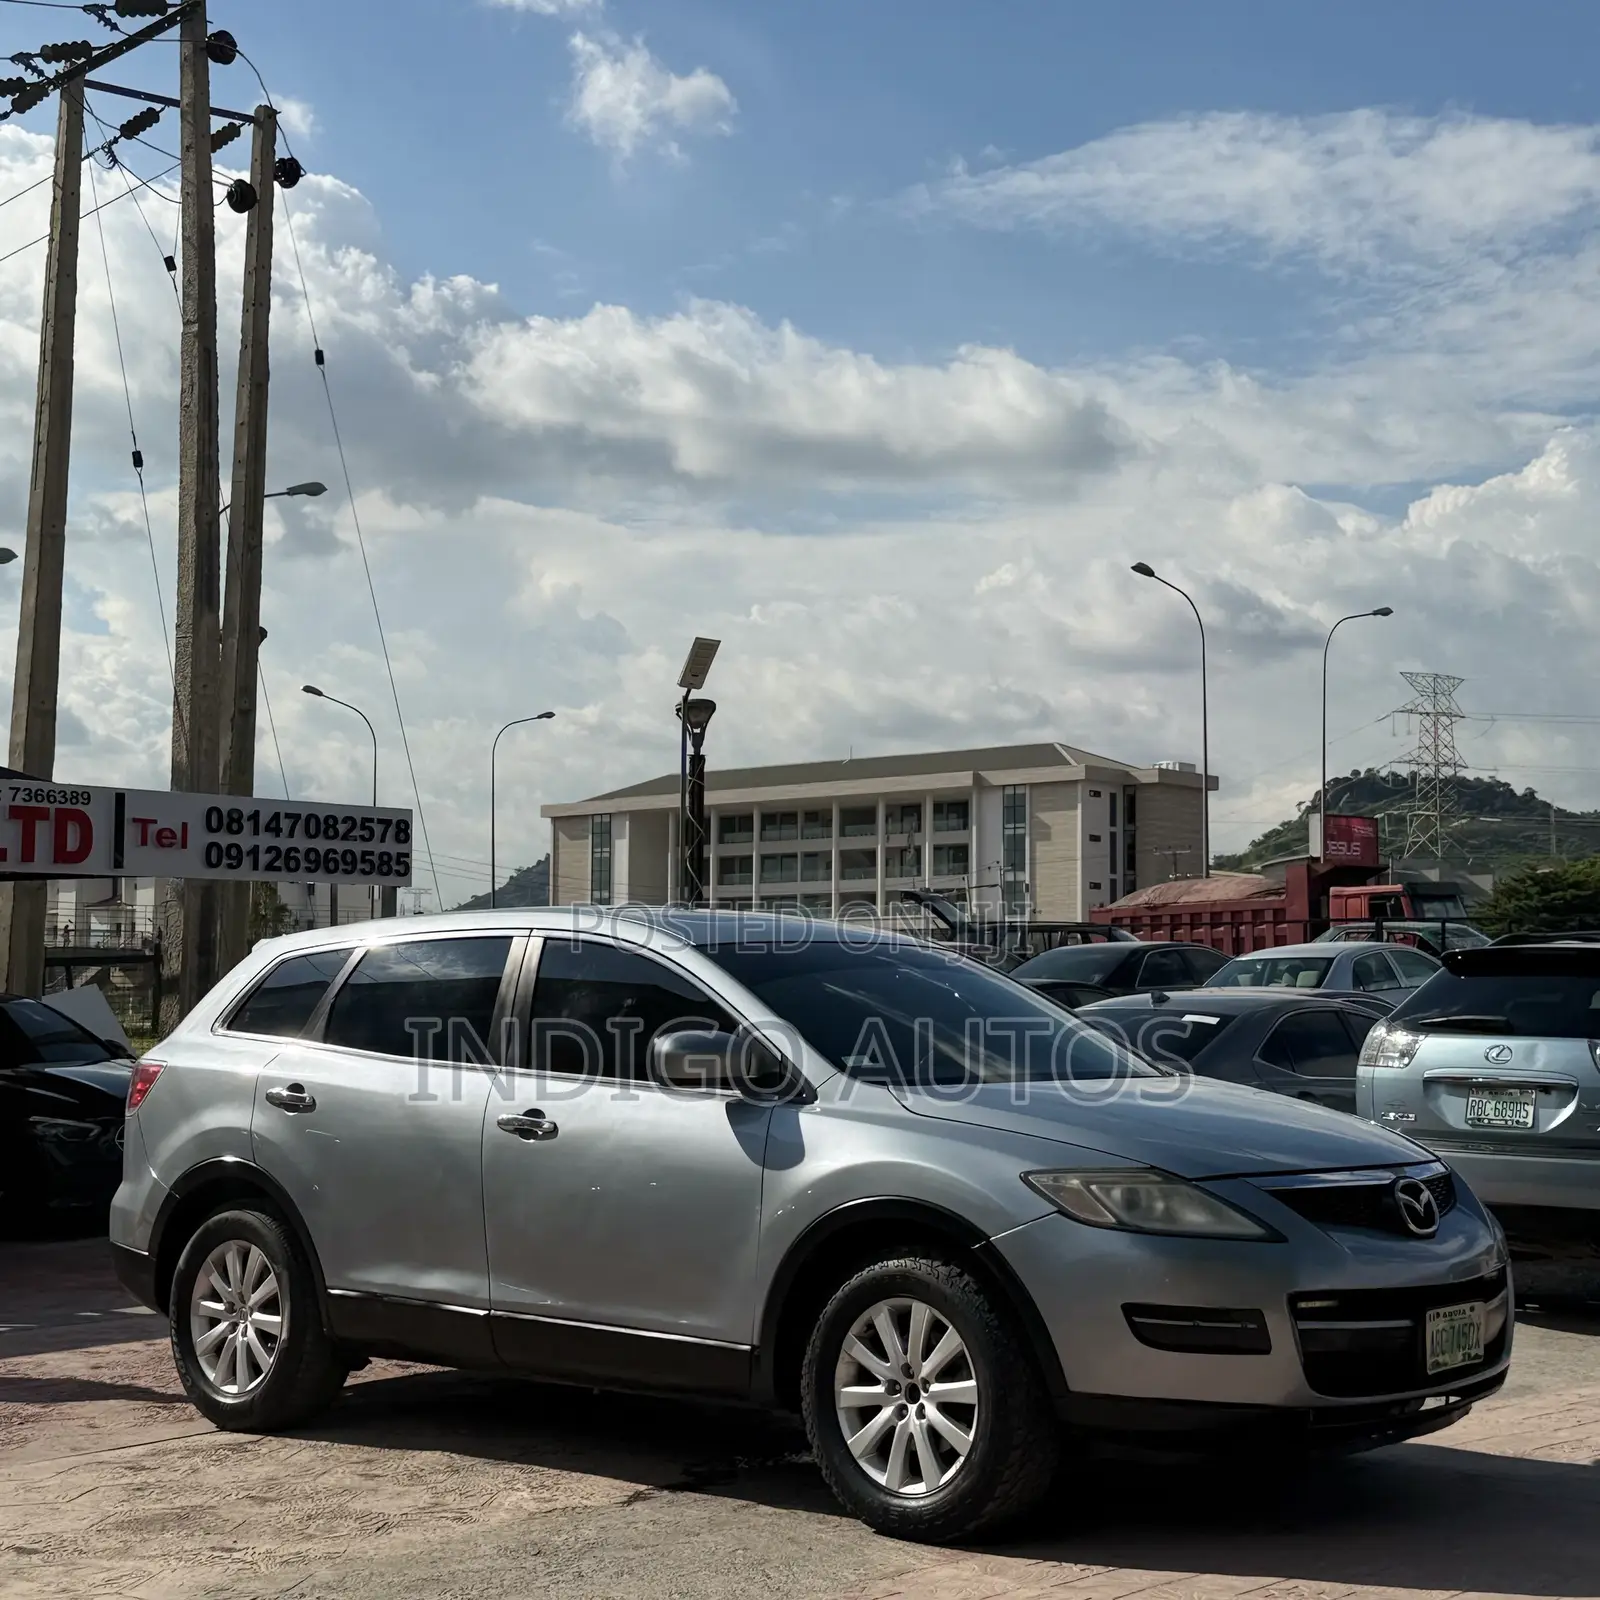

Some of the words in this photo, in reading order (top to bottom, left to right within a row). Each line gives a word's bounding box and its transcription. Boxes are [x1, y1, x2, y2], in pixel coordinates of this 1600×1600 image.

[8, 786, 91, 806] 7366389
[132, 817, 189, 849] Tel
[204, 806, 411, 844] 08147082578
[204, 841, 411, 877] 09126969585
[1325, 840, 1361, 855] JESUS
